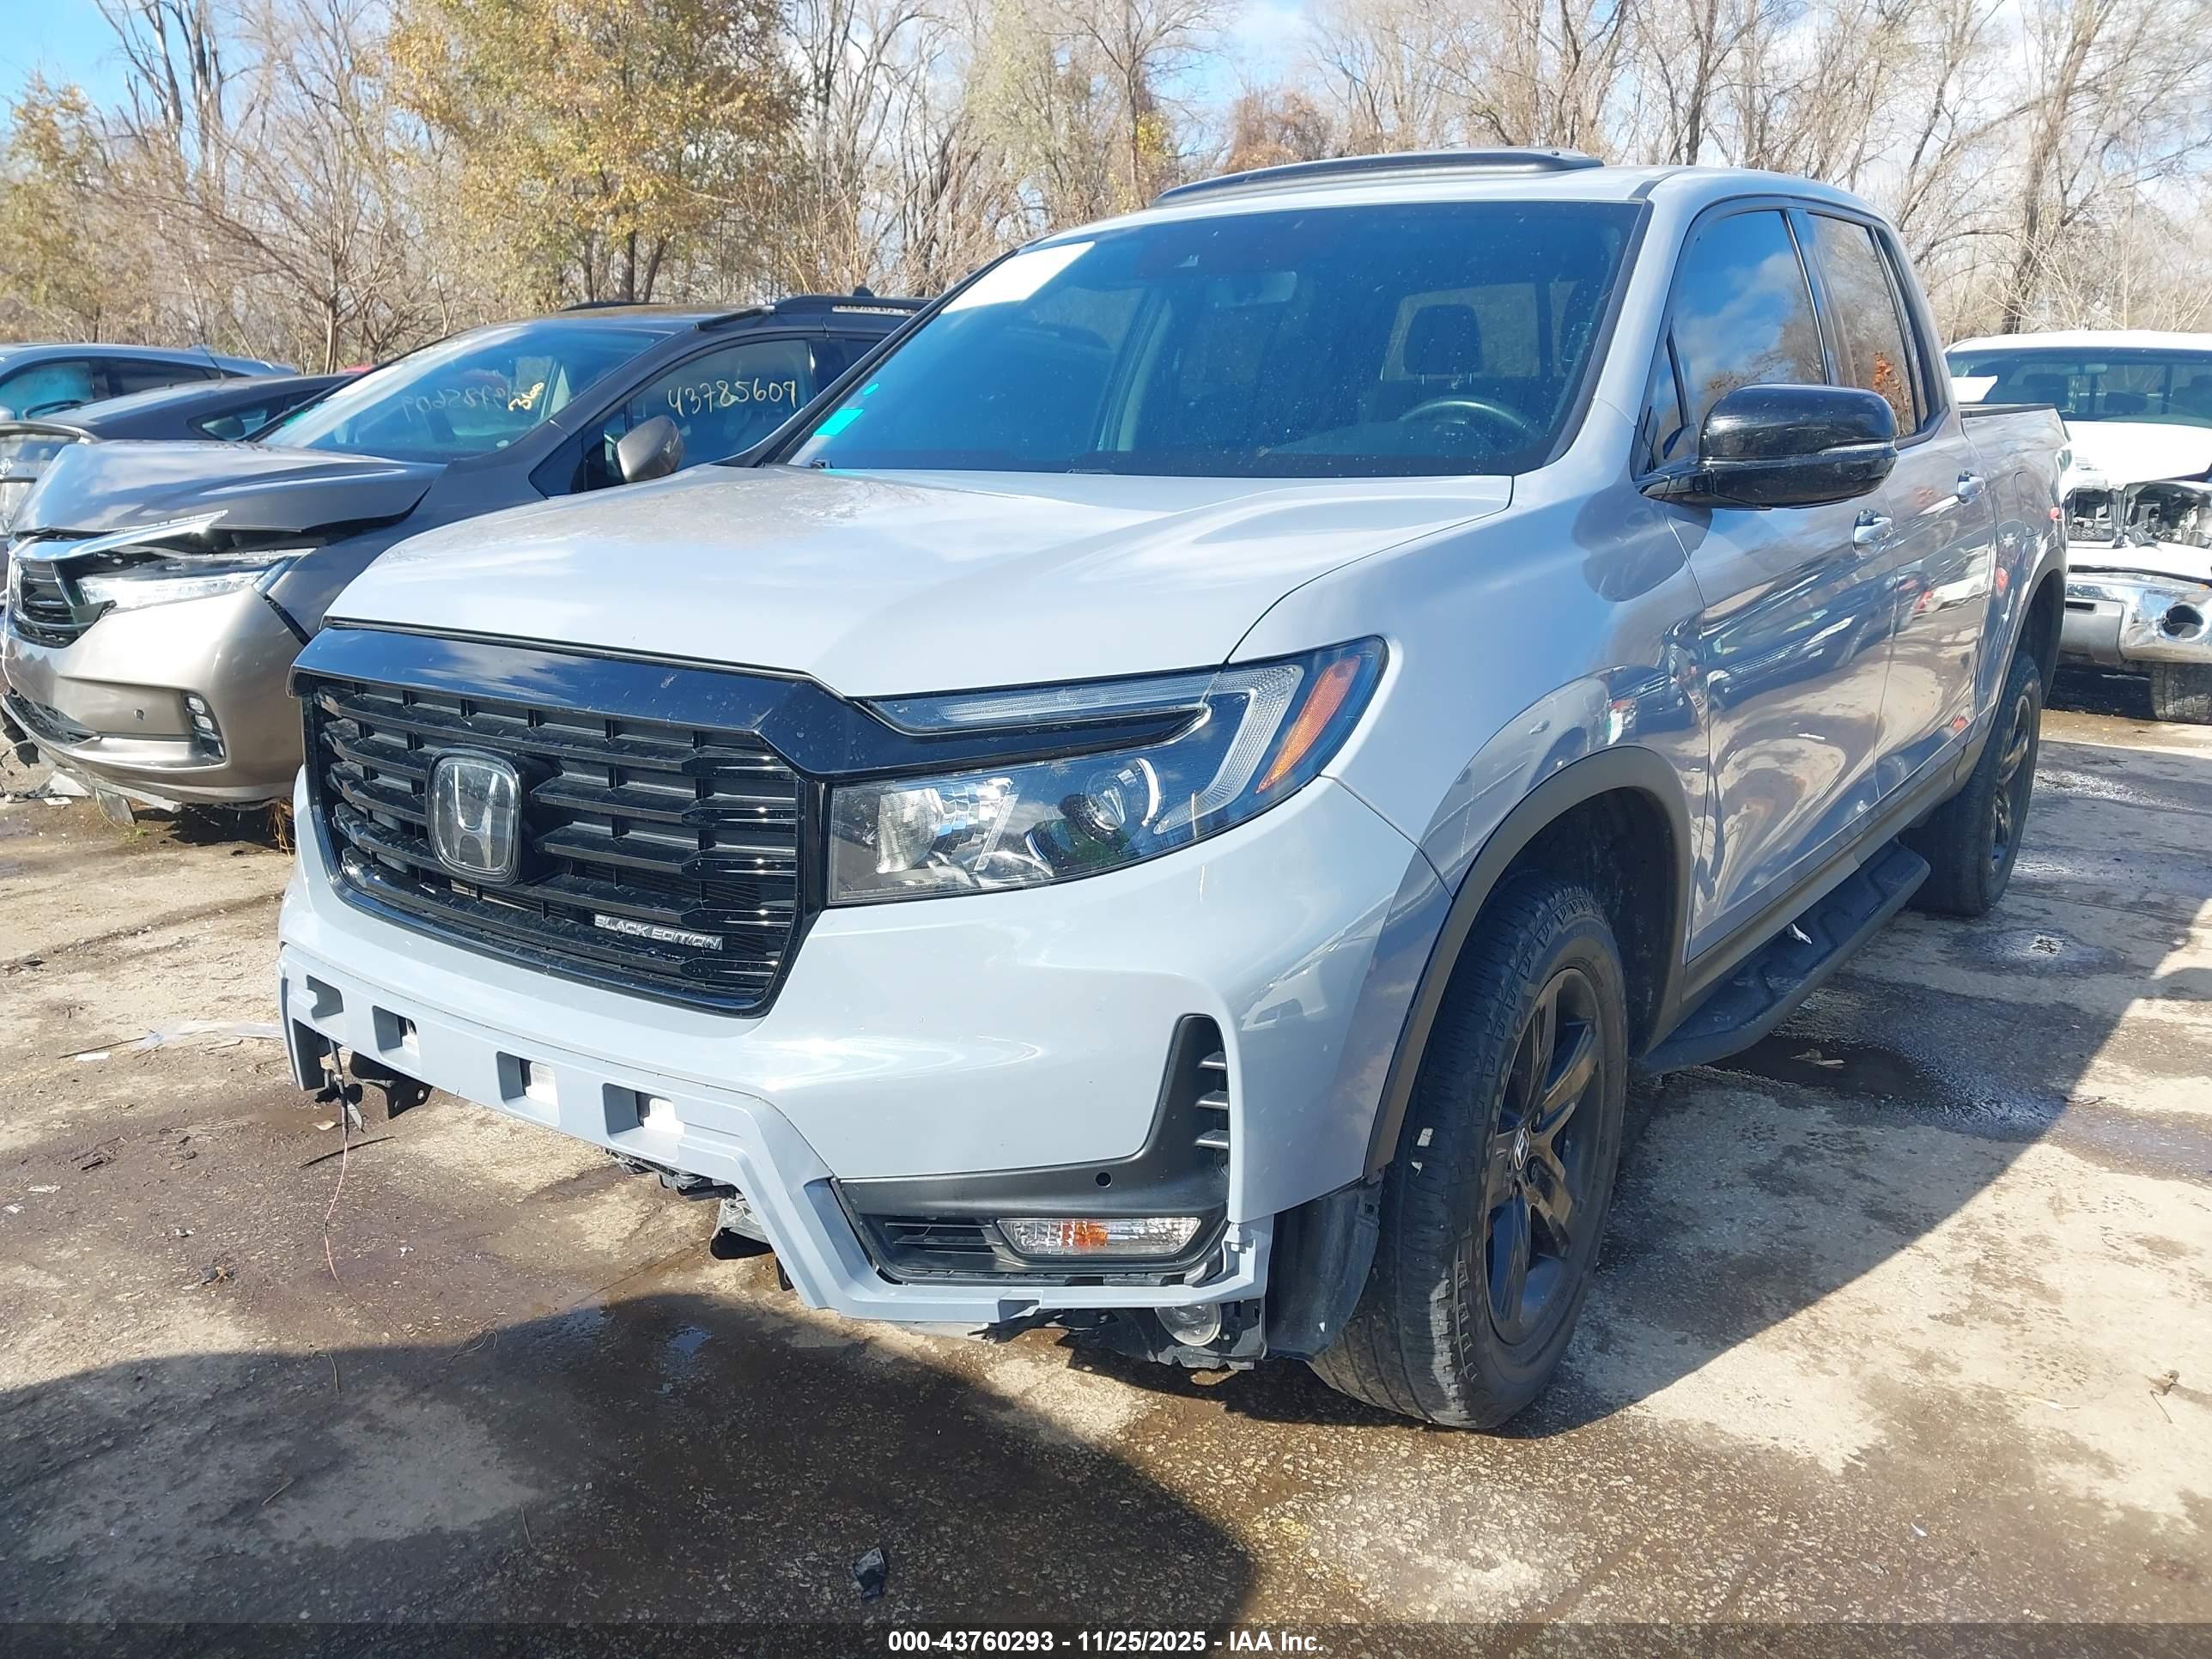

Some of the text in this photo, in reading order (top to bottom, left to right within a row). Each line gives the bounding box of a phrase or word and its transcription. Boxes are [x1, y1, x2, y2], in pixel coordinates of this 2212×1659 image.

[667, 377, 796, 418] 43785609
[594, 914, 723, 951] BLACK EDITION
